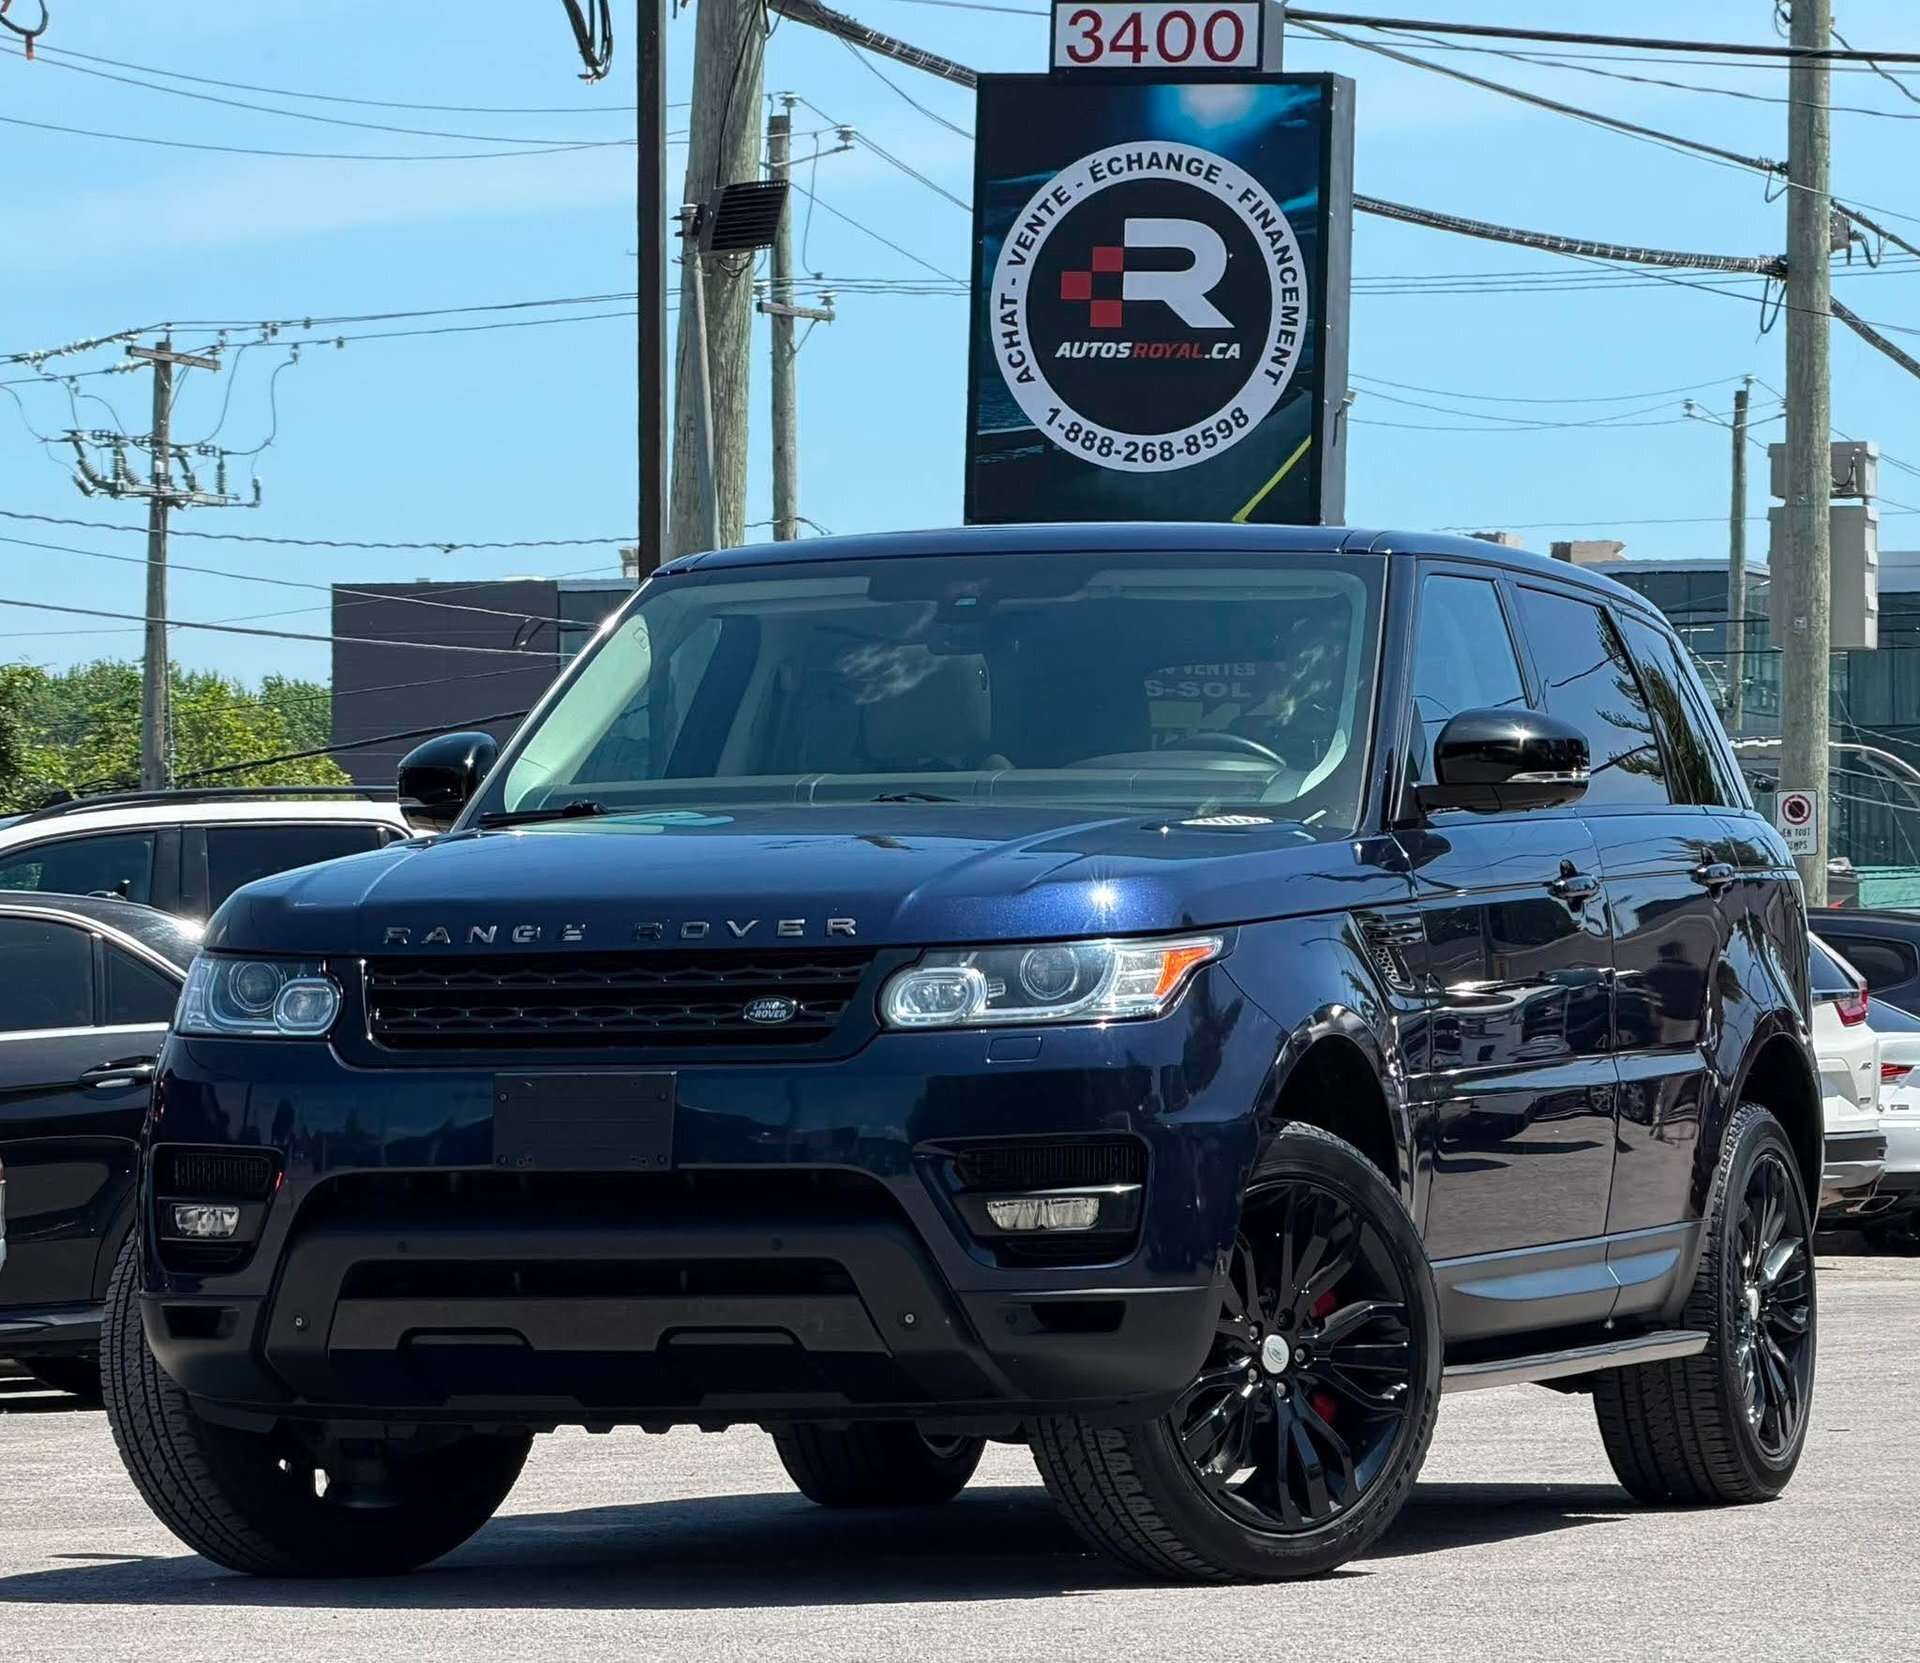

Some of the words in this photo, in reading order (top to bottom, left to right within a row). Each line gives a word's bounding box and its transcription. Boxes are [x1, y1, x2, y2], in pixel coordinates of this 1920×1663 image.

[1065, 9, 1246, 65] 3400
[1089, 151, 1222, 184] ÉCHANGE
[1007, 185, 1072, 267] VENTE
[1238, 187, 1300, 386] FINANCEMENT
[1000, 293, 1036, 384] ACHAT
[1054, 341, 1242, 360] AUTOSROYAL.CA
[1045, 406, 1250, 464] 1-888-268-8598
[383, 924, 587, 945] RANGE
[635, 917, 857, 941] ROVER
